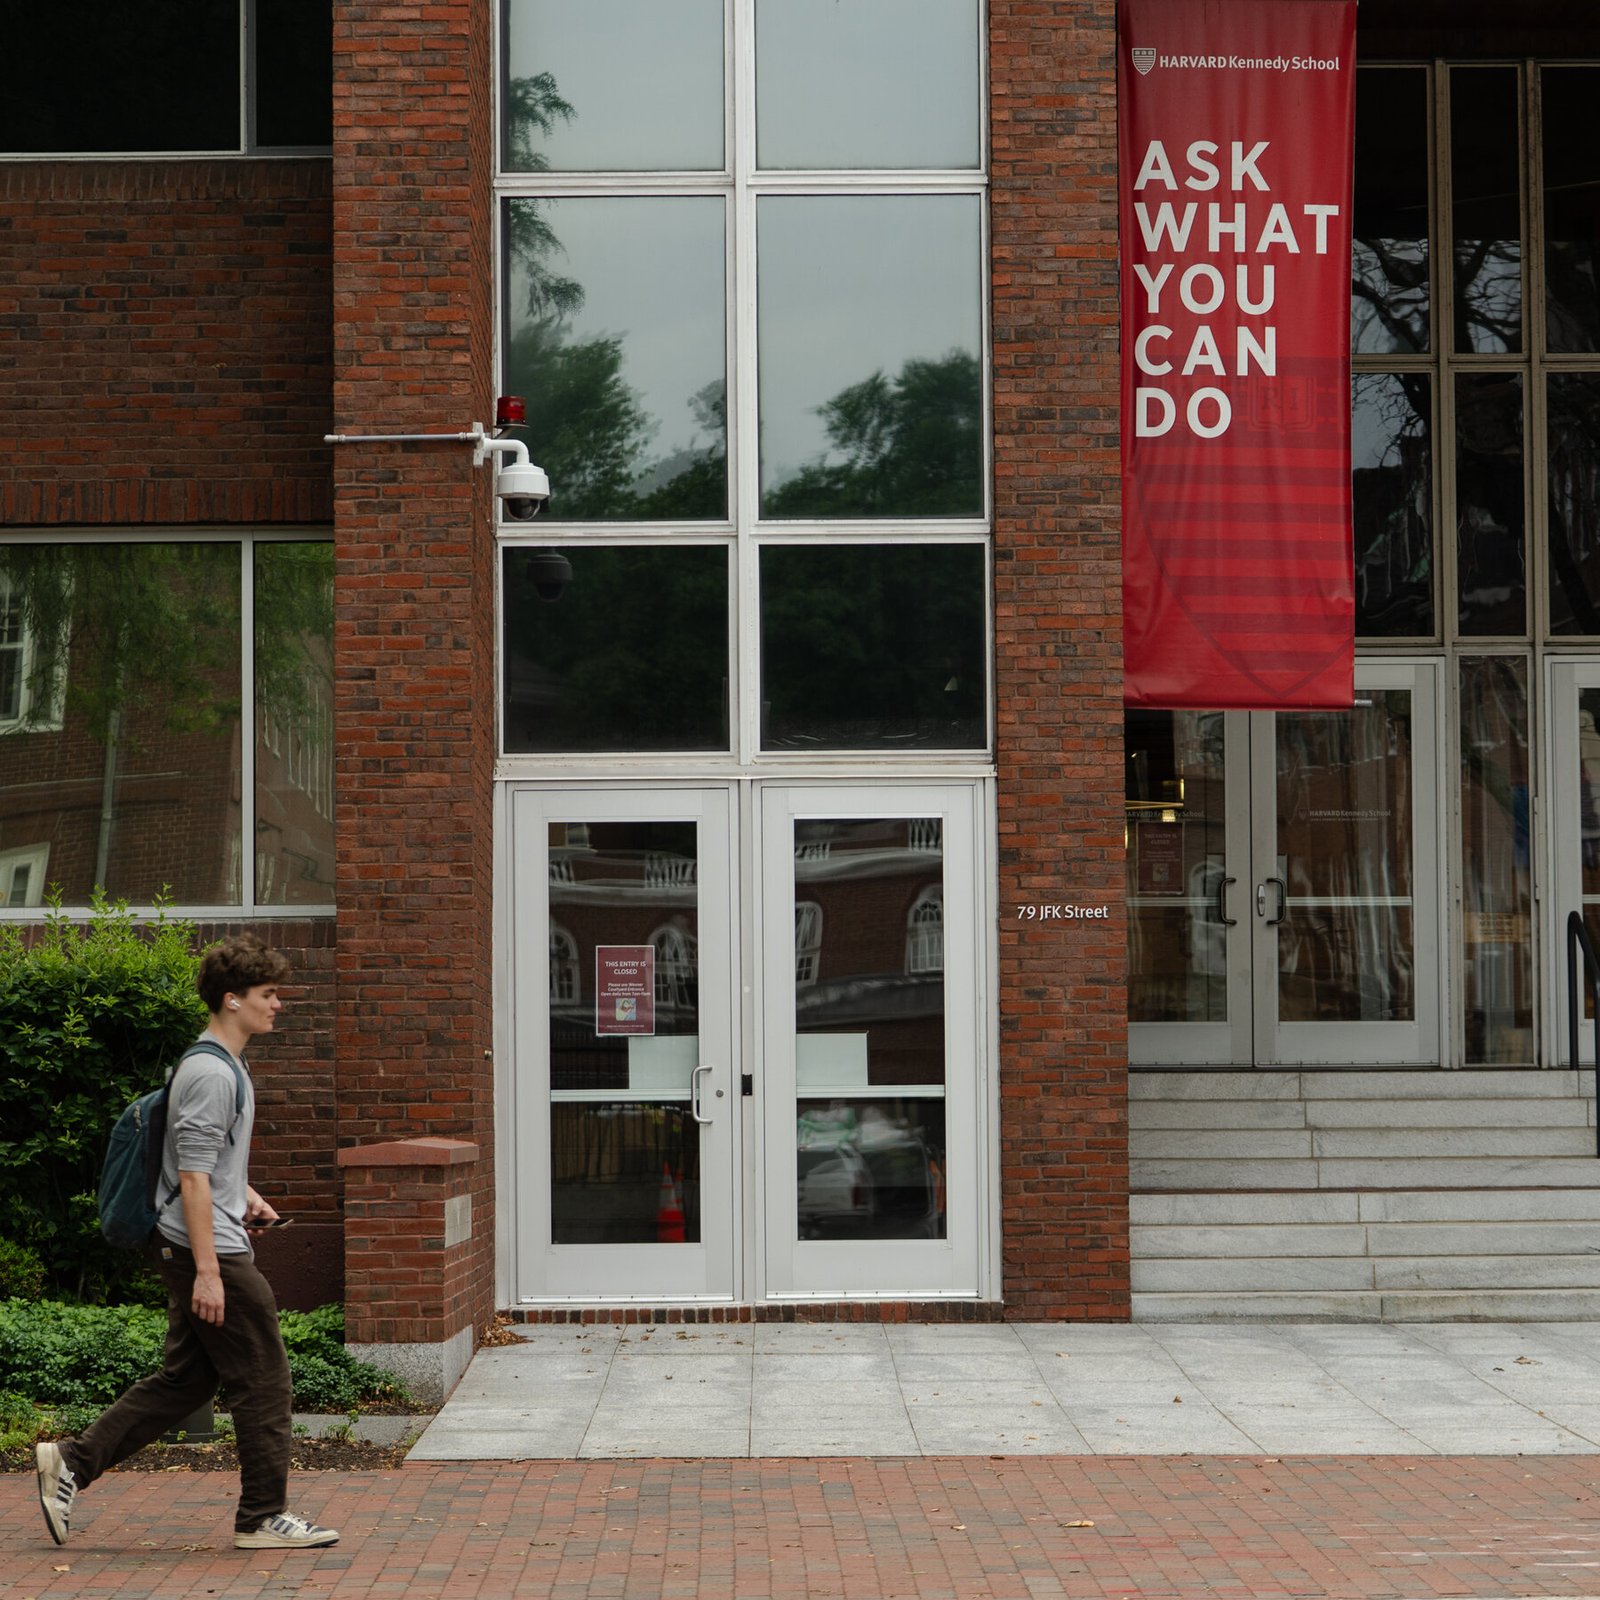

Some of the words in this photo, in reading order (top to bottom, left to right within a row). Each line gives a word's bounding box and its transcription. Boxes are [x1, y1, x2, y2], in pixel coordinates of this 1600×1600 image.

[1159, 55, 1227, 68] HARVARD
[1229, 55, 1290, 73] Kennedy
[1292, 56, 1340, 71] School
[1133, 140, 1271, 192] ASK
[1133, 202, 1340, 254] WHAT
[1132, 263, 1275, 315] YOU
[1134, 324, 1277, 377] CAN
[1135, 387, 1232, 439] DO
[1341, 810, 1369, 818] Kennedy
[1368, 809, 1391, 817] School
[1017, 906, 1036, 919] 79
[1039, 905, 1061, 921] JFK
[1064, 905, 1109, 918] Street
